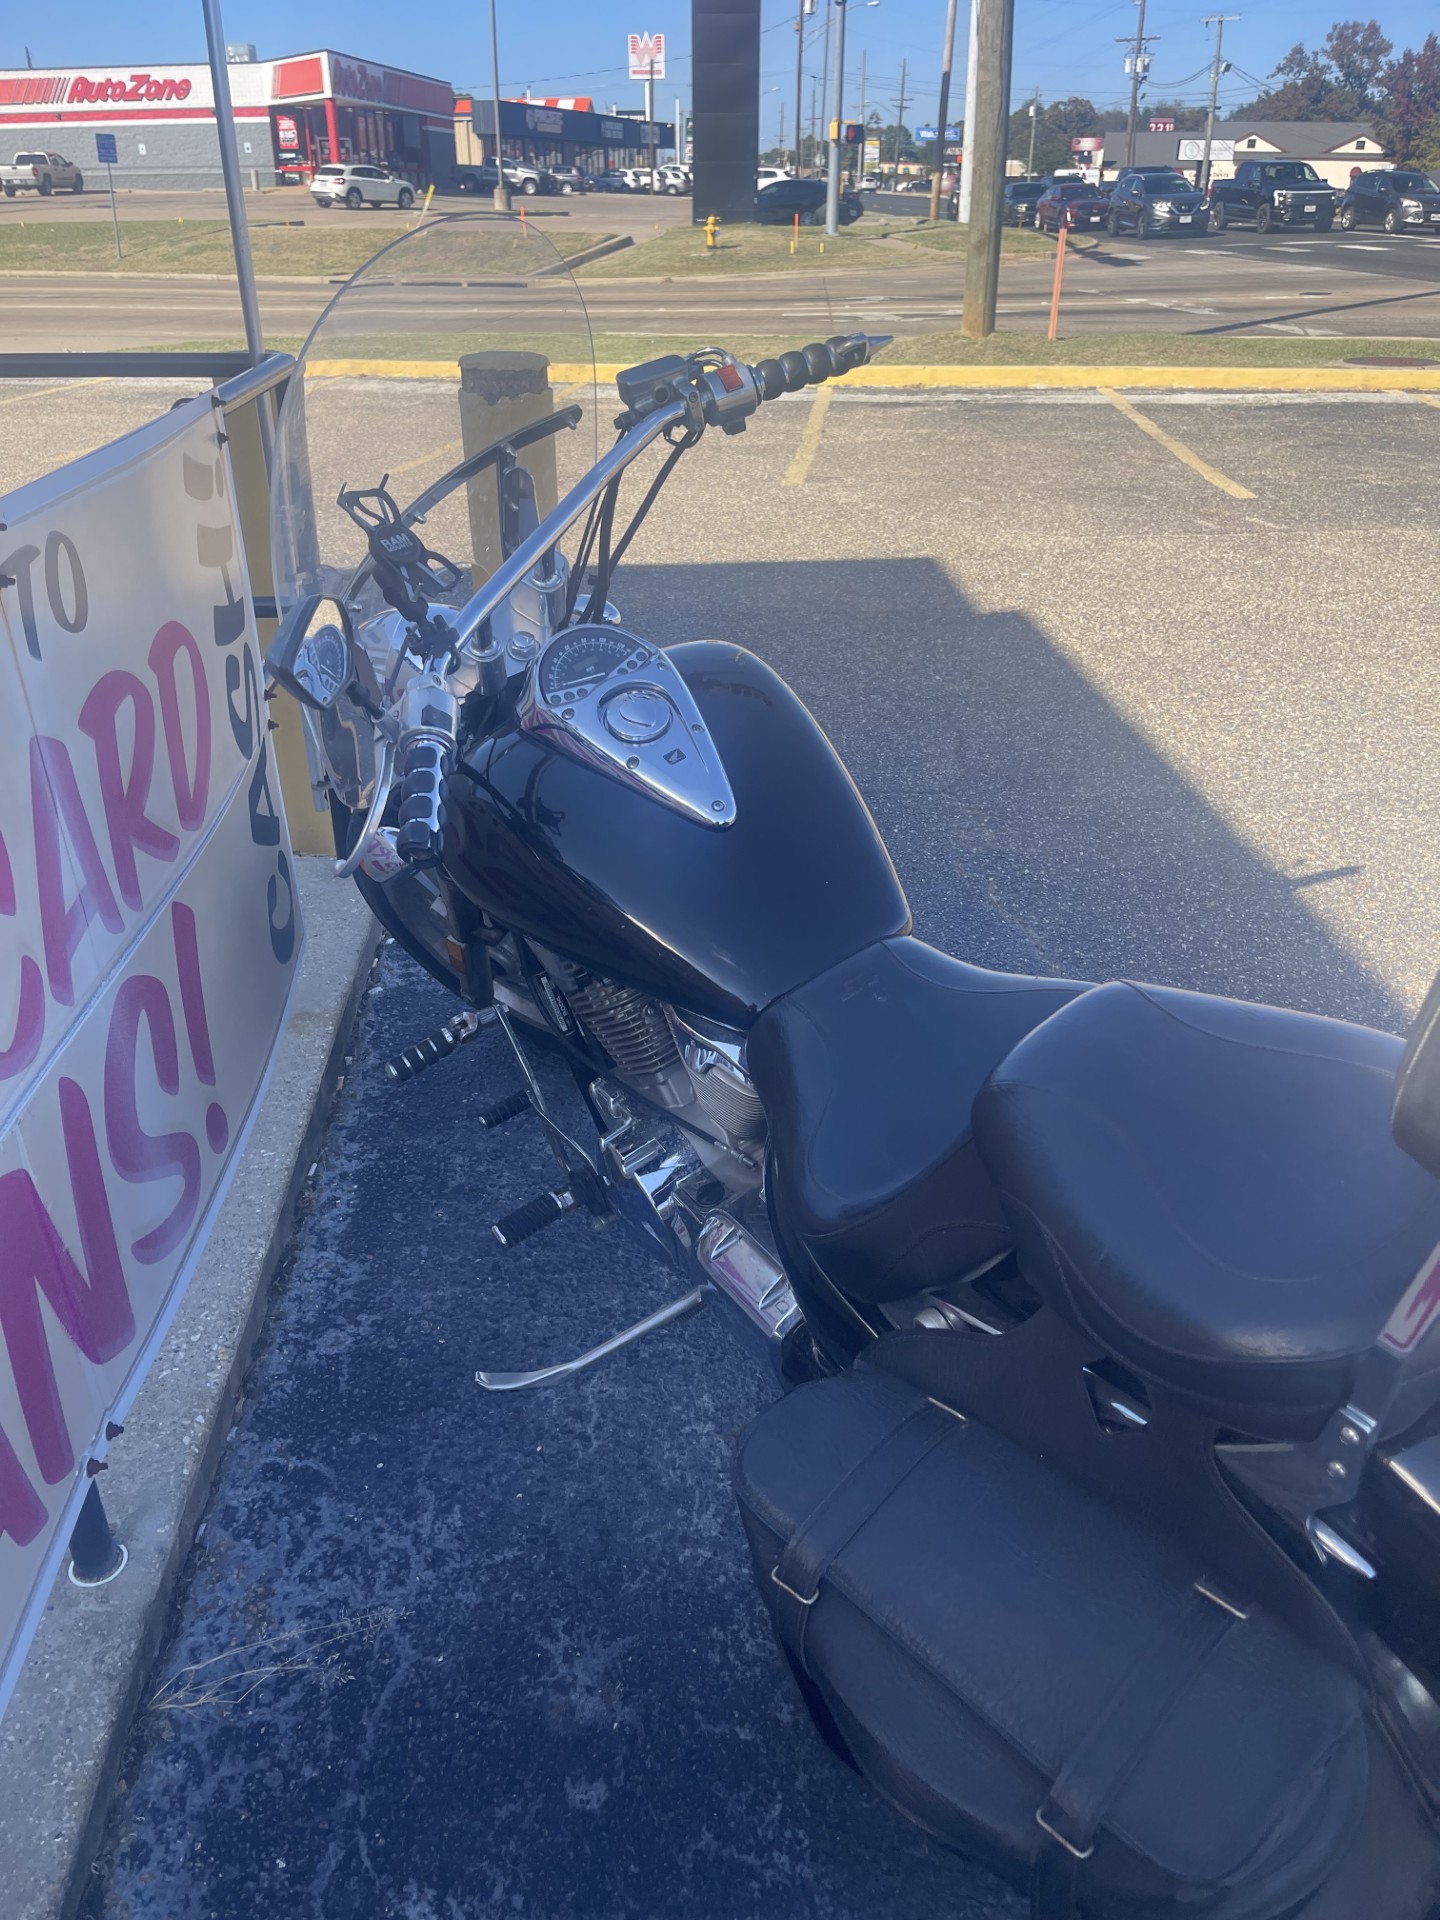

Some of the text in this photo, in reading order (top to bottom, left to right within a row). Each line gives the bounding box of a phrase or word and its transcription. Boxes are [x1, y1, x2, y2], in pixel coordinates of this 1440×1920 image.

[67, 74, 192, 103] AutoZone
[380, 533, 413, 552] RAM
[0, 530, 88, 661] TO
[182, 451, 296, 964] CASH!
